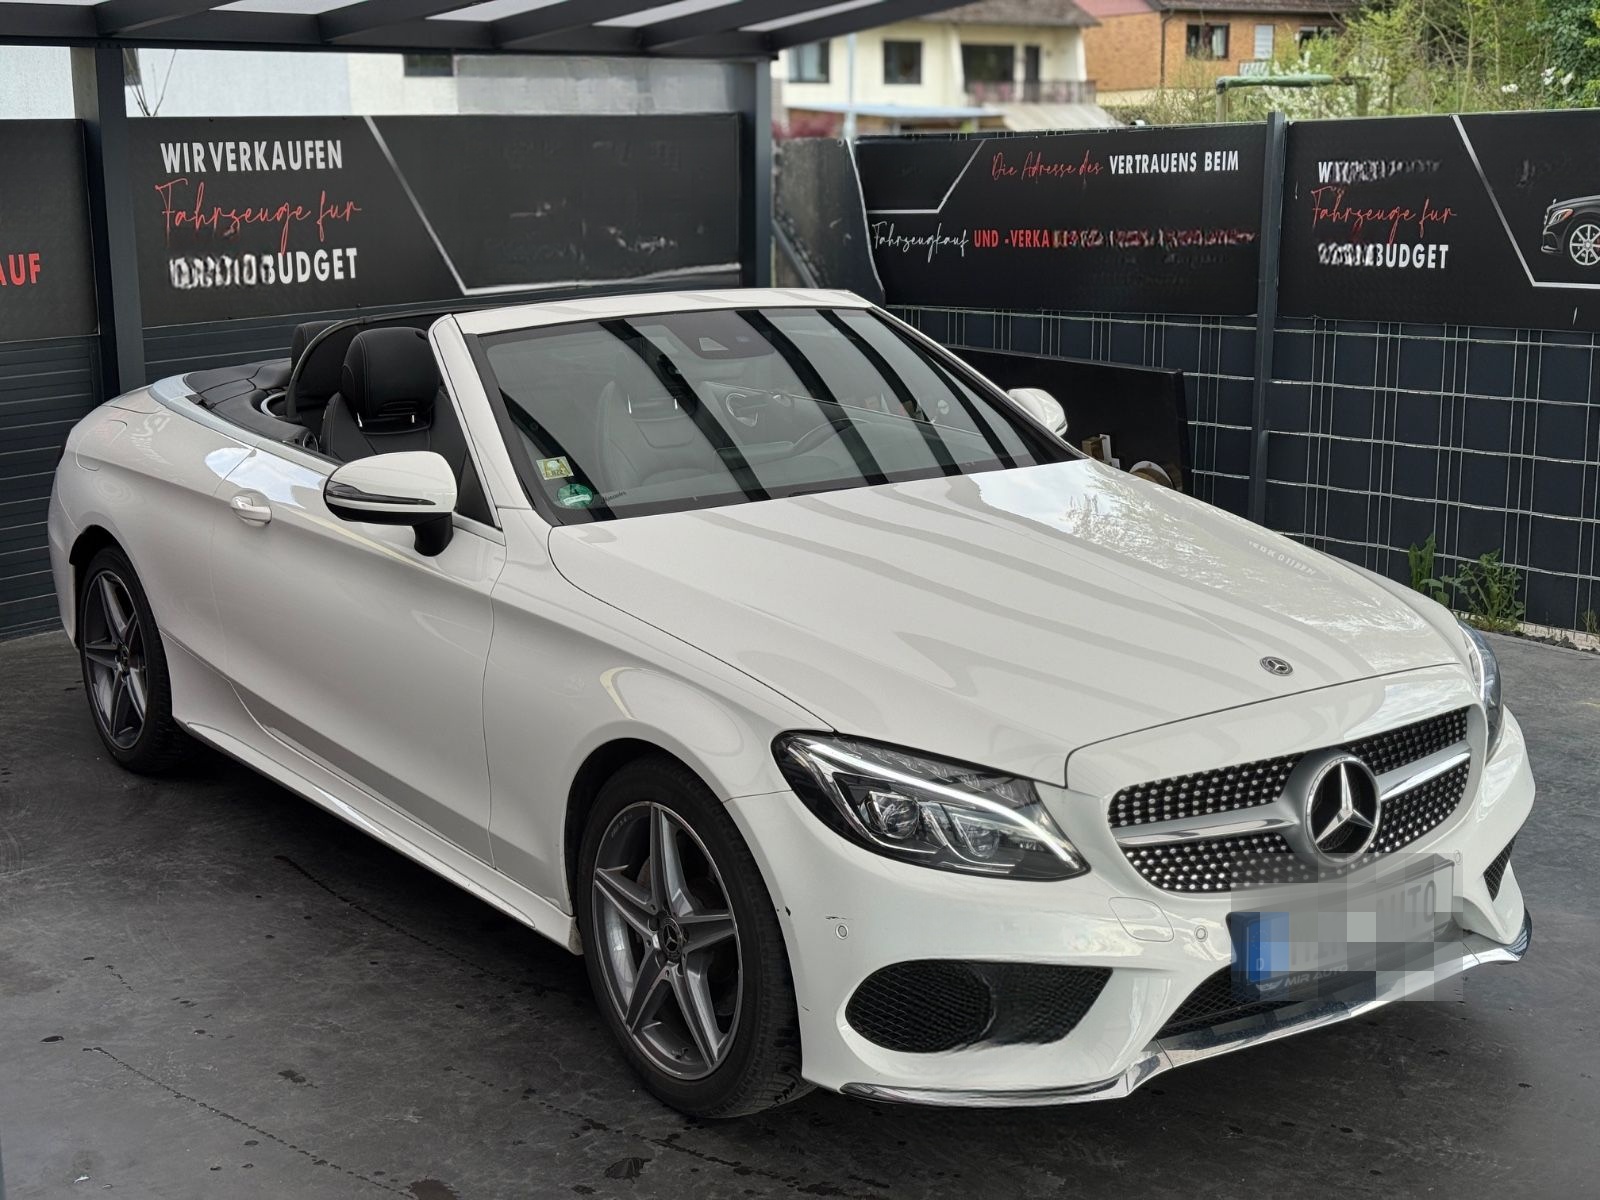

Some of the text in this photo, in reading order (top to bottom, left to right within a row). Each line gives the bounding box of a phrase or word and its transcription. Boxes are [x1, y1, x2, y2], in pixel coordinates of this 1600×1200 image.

[160, 140, 343, 174] WIR VERKAUFEN
[1109, 152, 1197, 175] VERTRAUENS
[1203, 150, 1239, 172] BEIM
[973, 229, 999, 248] UND
